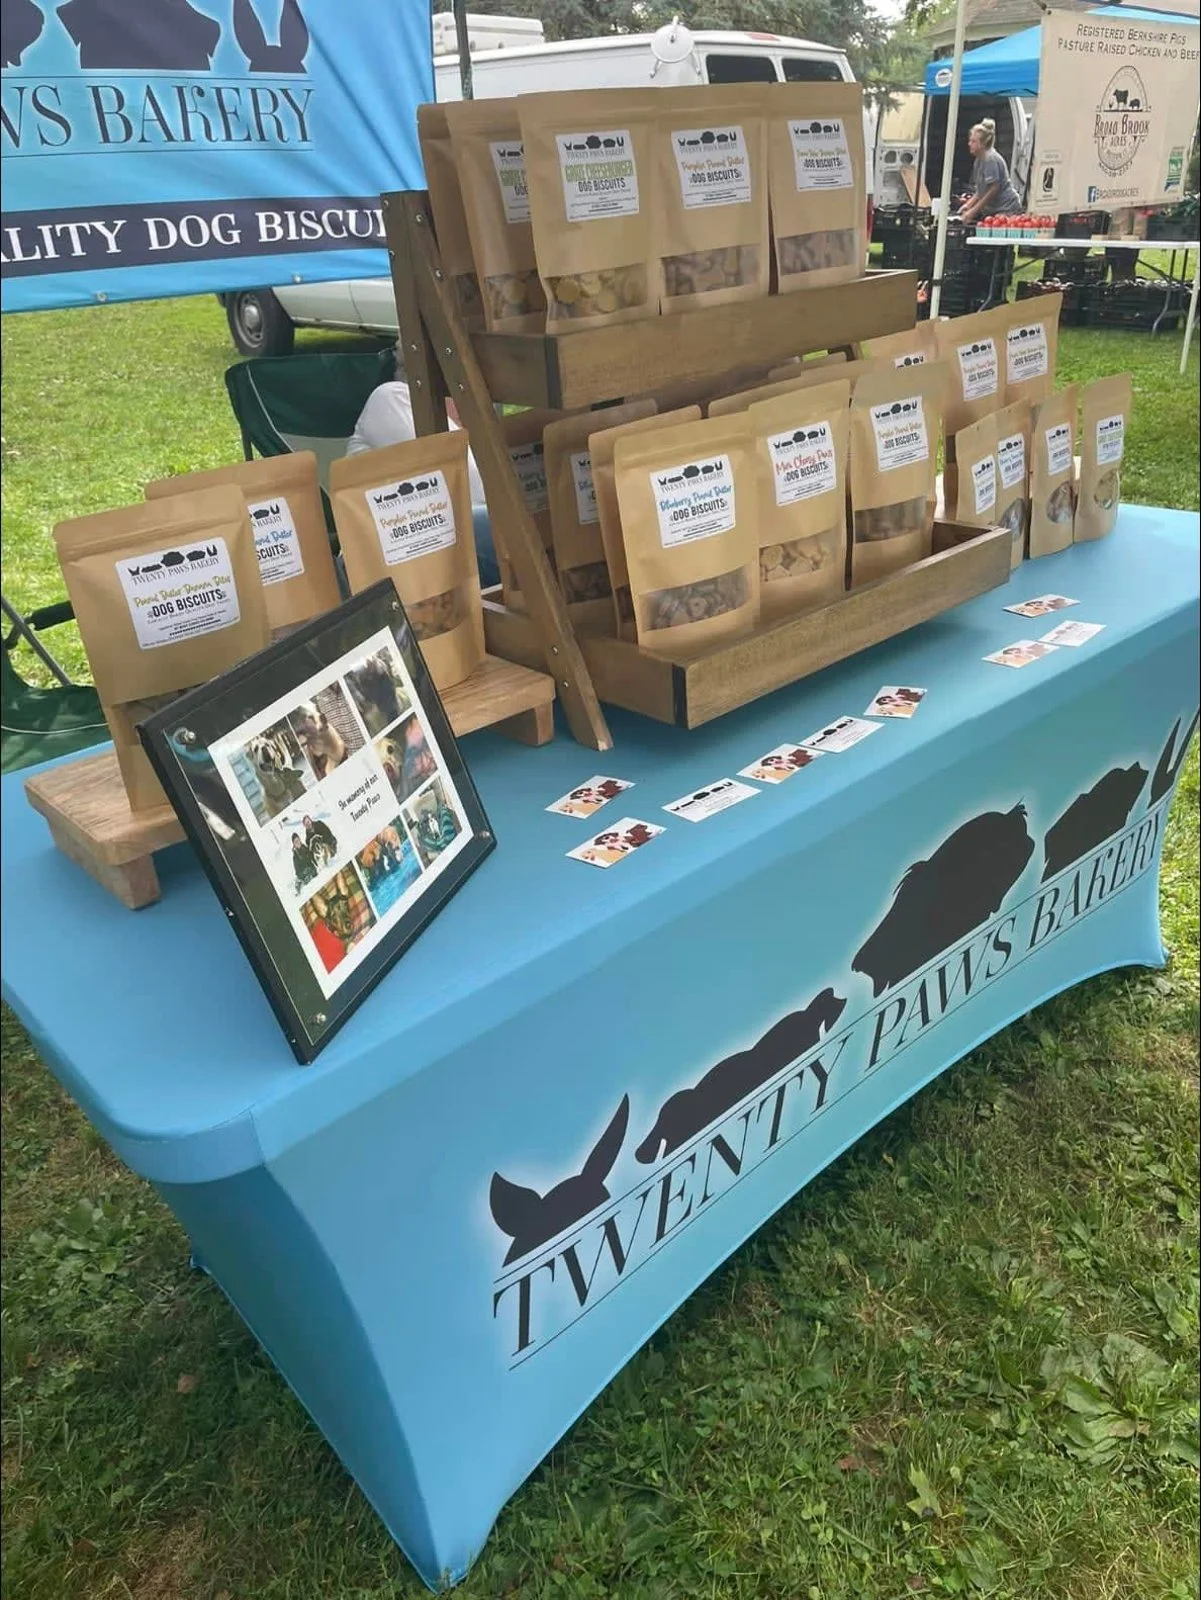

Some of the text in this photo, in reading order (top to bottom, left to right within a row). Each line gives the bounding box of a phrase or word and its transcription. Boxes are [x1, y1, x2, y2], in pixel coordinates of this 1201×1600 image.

[1077, 24, 1187, 45] REGISTERED BERKSHIRE PIGS
[1058, 38, 1095, 53] PASTURE
[1097, 41, 1126, 55] RAISED
[1128, 44, 1161, 57] CHICKEN
[1163, 49, 1178, 59] AND
[85, 84, 314, 144] BAKERY
[1094, 113, 1149, 137] BROAD BROOK
[816, 157, 840, 168] BISCUITS
[578, 178, 626, 192] DOG BISCUITS
[692, 173, 707, 184] DOG
[707, 168, 740, 182] BISCUITS
[1, 220, 127, 262] LITY
[144, 212, 242, 251] DOG
[895, 432, 918, 447] BISCUITS
[786, 461, 827, 482] DOG BISCUITS
[673, 509, 690, 522] DOG
[690, 498, 725, 517] BISCUITS
[392, 525, 409, 539] DOG
[409, 514, 444, 532] BISCUITS
[131, 557, 220, 587] TWENTY PAWS BAKERY
[152, 588, 223, 618] DOG BISCUITS
[493, 1032, 854, 1356] TWENTY
[864, 914, 1018, 1072] PAWS
